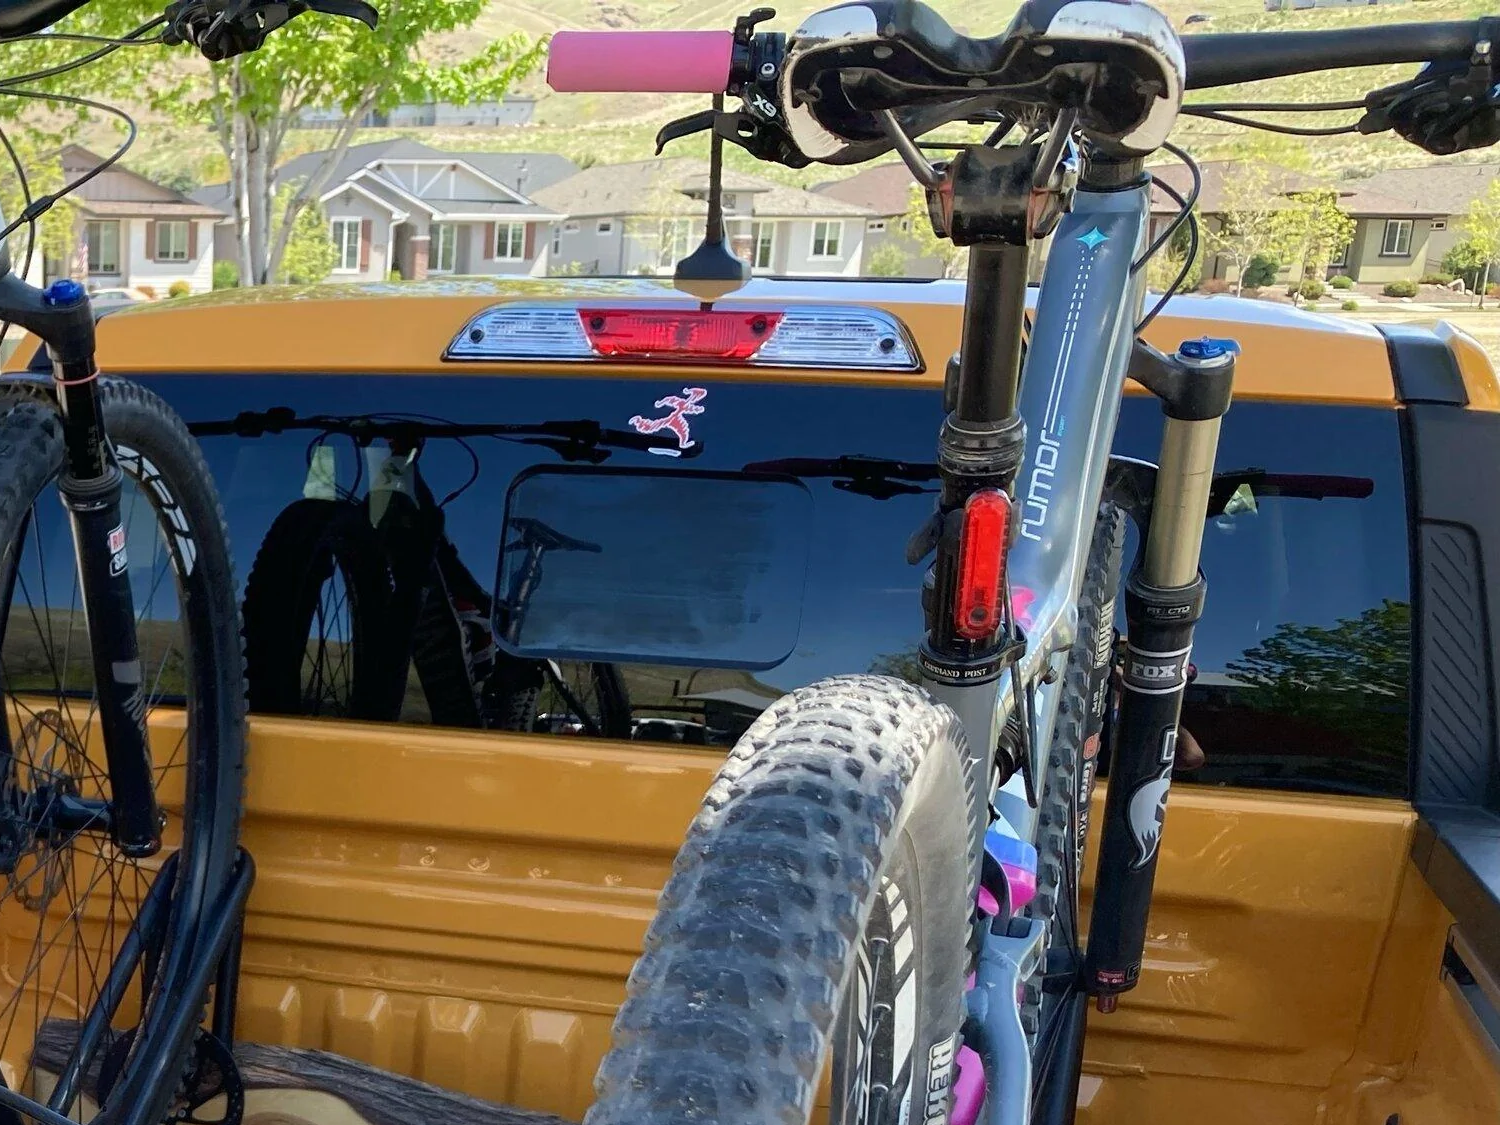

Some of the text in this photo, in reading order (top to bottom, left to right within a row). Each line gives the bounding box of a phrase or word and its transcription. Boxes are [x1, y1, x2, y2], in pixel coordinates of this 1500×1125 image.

[1020, 429, 1061, 541] rumor
[964, 667, 988, 678] POST
[1131, 662, 1178, 678] FOX
